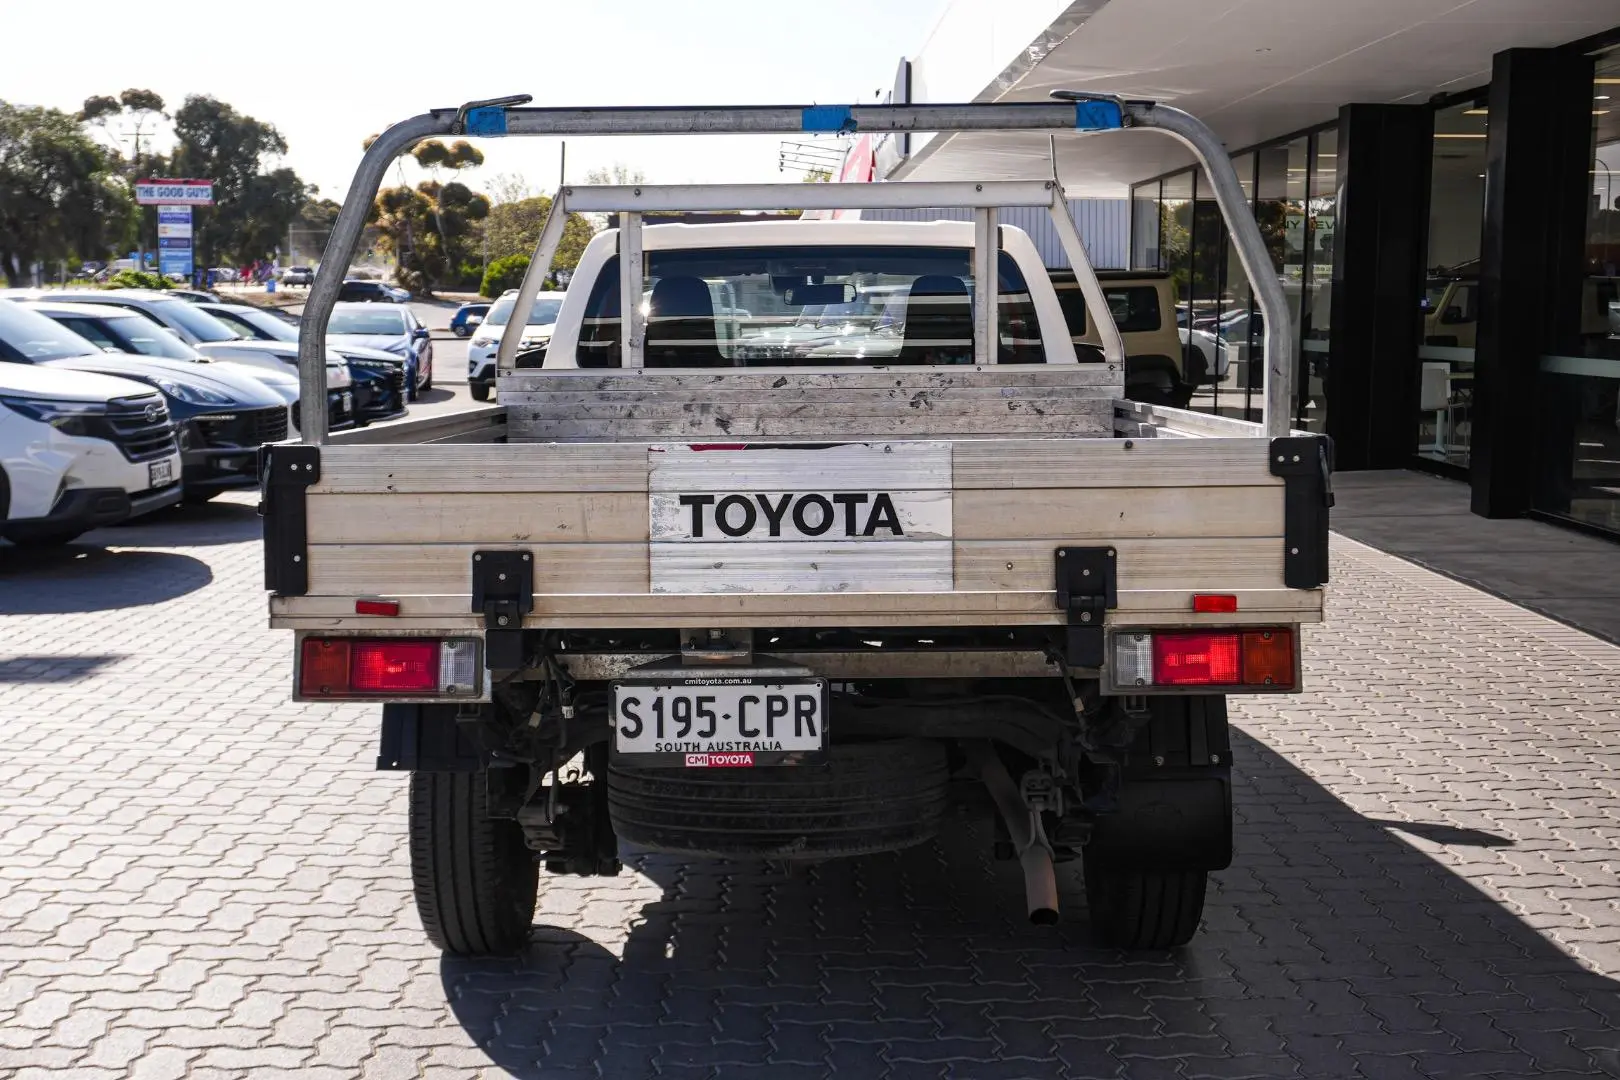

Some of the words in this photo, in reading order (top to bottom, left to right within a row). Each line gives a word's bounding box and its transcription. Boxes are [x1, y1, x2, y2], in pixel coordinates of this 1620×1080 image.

[138, 187, 154, 197] THE
[157, 187, 183, 198] GOOD
[186, 187, 209, 198] GUYS
[679, 493, 904, 538] TOYOTA
[684, 677, 752, 686] cmitoyota.com.au
[655, 742, 700, 752] SOUTH
[707, 741, 782, 752] AUSTRALIA
[687, 755, 708, 765] CMI
[709, 755, 752, 765] TOYOTA
